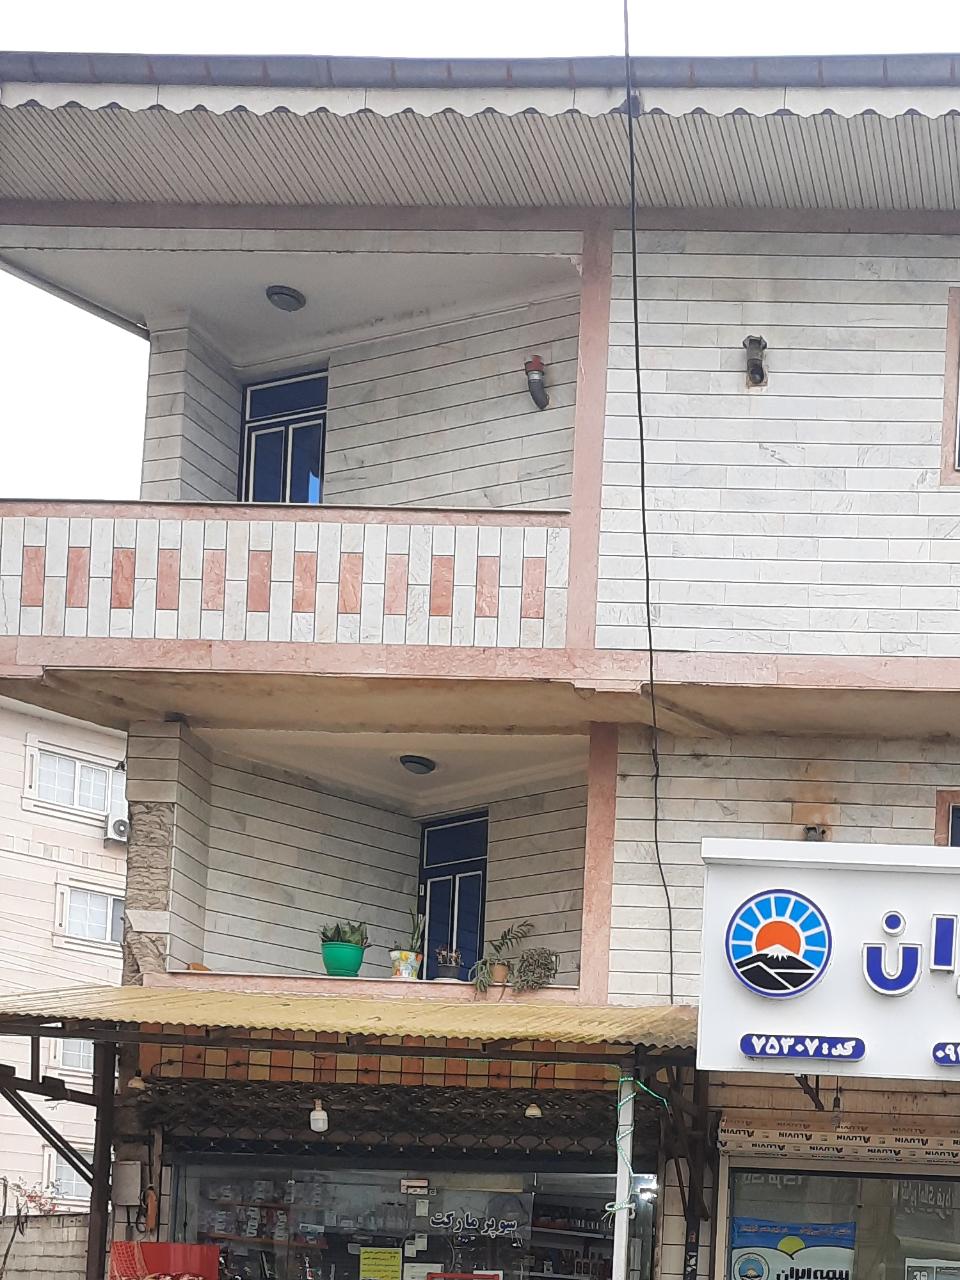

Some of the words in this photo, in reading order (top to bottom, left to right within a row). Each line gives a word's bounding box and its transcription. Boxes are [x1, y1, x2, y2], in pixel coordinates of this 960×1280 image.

[751, 1035, 819, 1056] ۷۵۳۰۷
[430, 1211, 479, 1232] مارکت
[481, 1218, 518, 1238] سوپر
